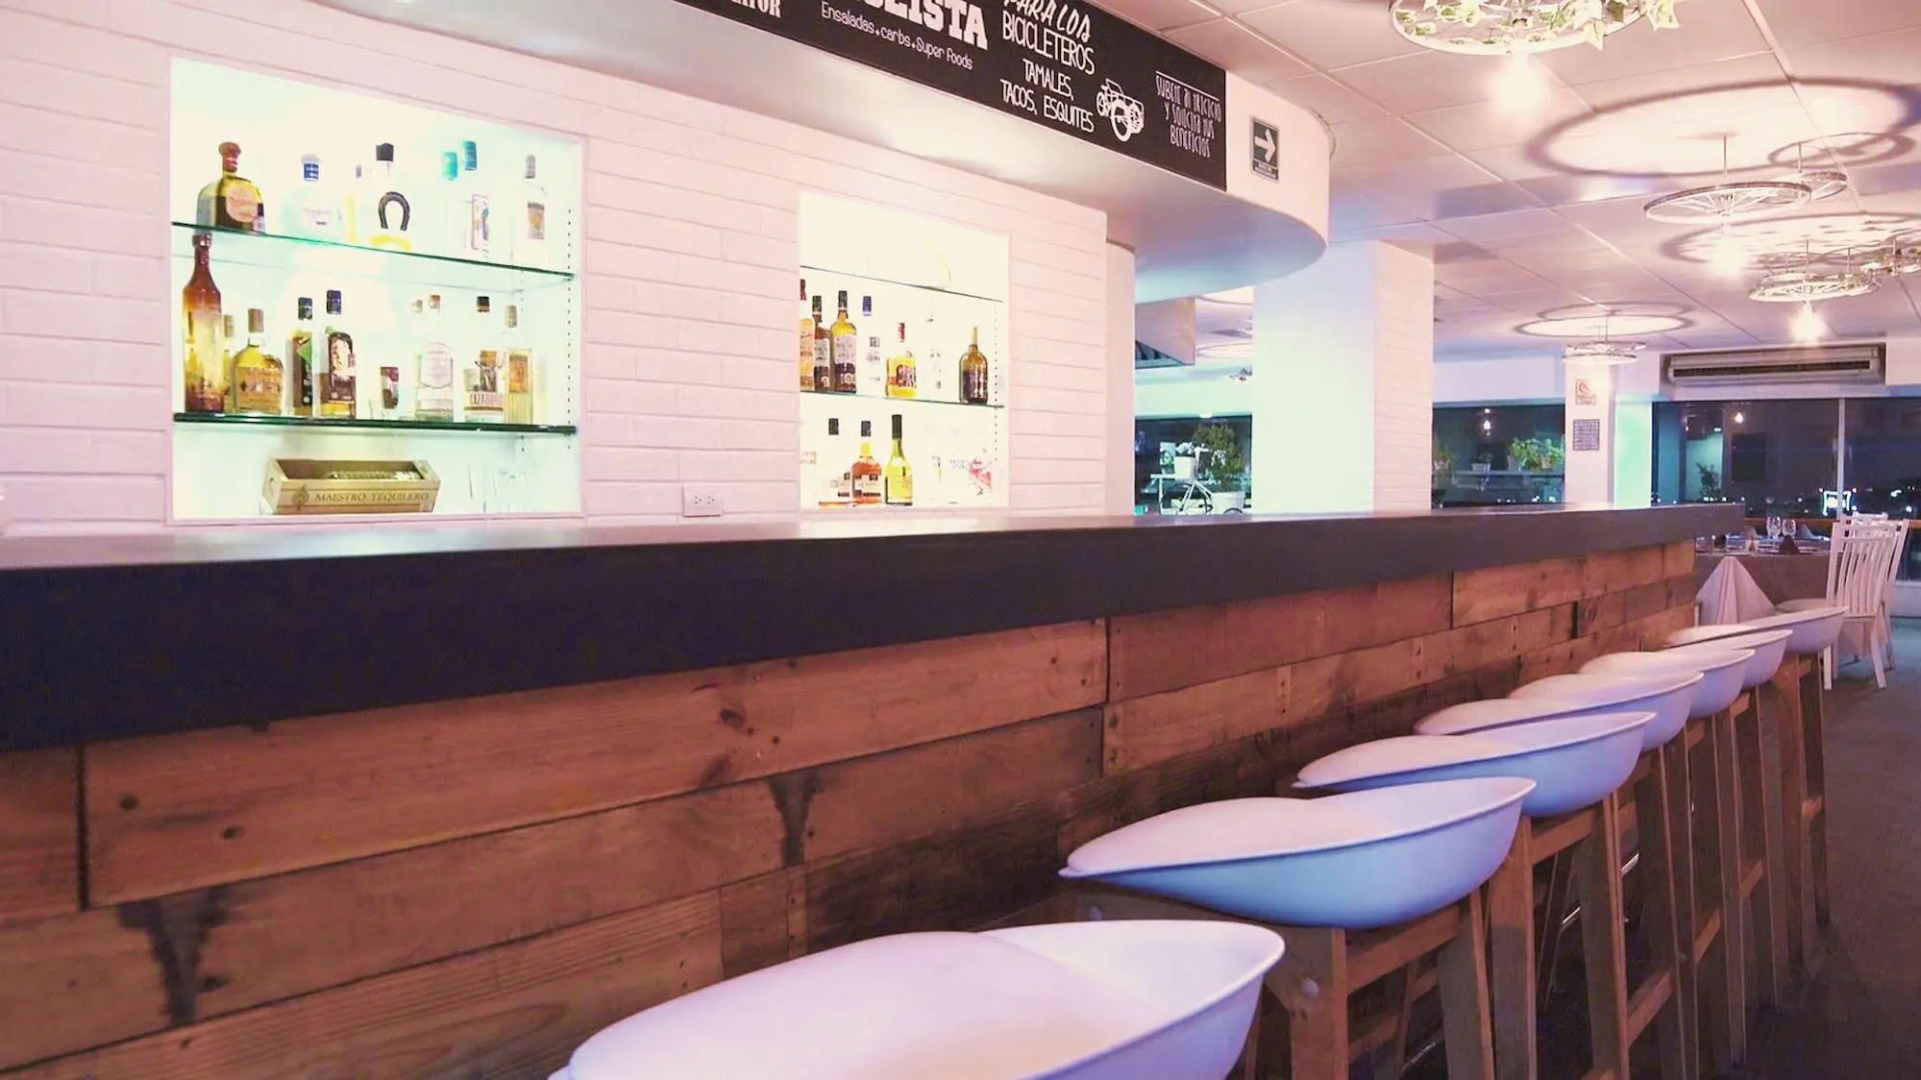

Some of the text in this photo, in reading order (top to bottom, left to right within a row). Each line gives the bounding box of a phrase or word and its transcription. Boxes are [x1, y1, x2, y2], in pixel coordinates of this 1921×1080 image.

[821, 1, 875, 35] Ensaladas
[880, 26, 911, 48] carbs
[916, 37, 945, 58] Super
[864, 0, 988, 50] ISTA
[1003, 0, 1091, 43] ARA LOS
[1003, 9, 1095, 75] BICICLETEROS
[1023, 57, 1074, 101] TAMALES,
[1000, 78, 1095, 133] TACOS, ESQUITES
[315, 492, 430, 502] MAESTRO TEQUILERO
